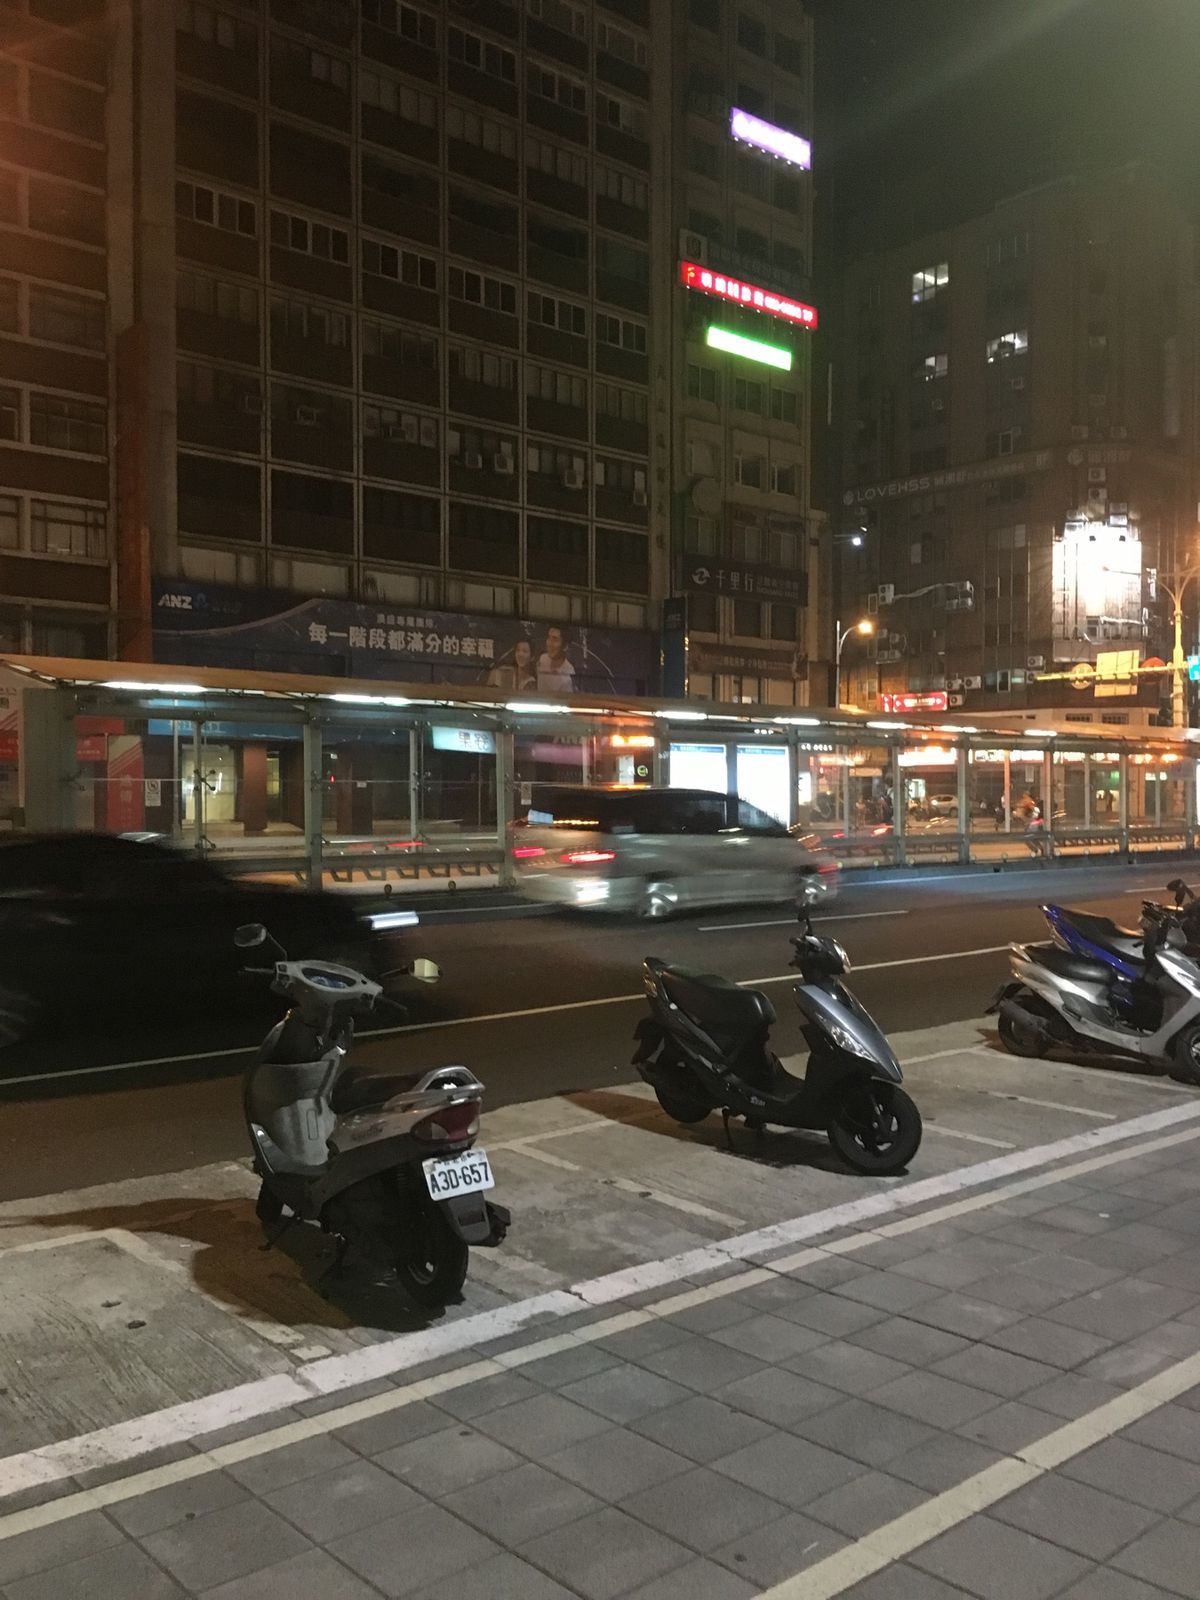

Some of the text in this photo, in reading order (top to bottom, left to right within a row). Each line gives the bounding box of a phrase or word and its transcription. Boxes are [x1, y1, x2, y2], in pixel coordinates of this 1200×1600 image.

[715, 569, 754, 593] 千里行
[157, 592, 193, 610] ANZ
[307, 621, 495, 659] 每一階段都滿分的幸福
[430, 1161, 489, 1194] A3D-657
